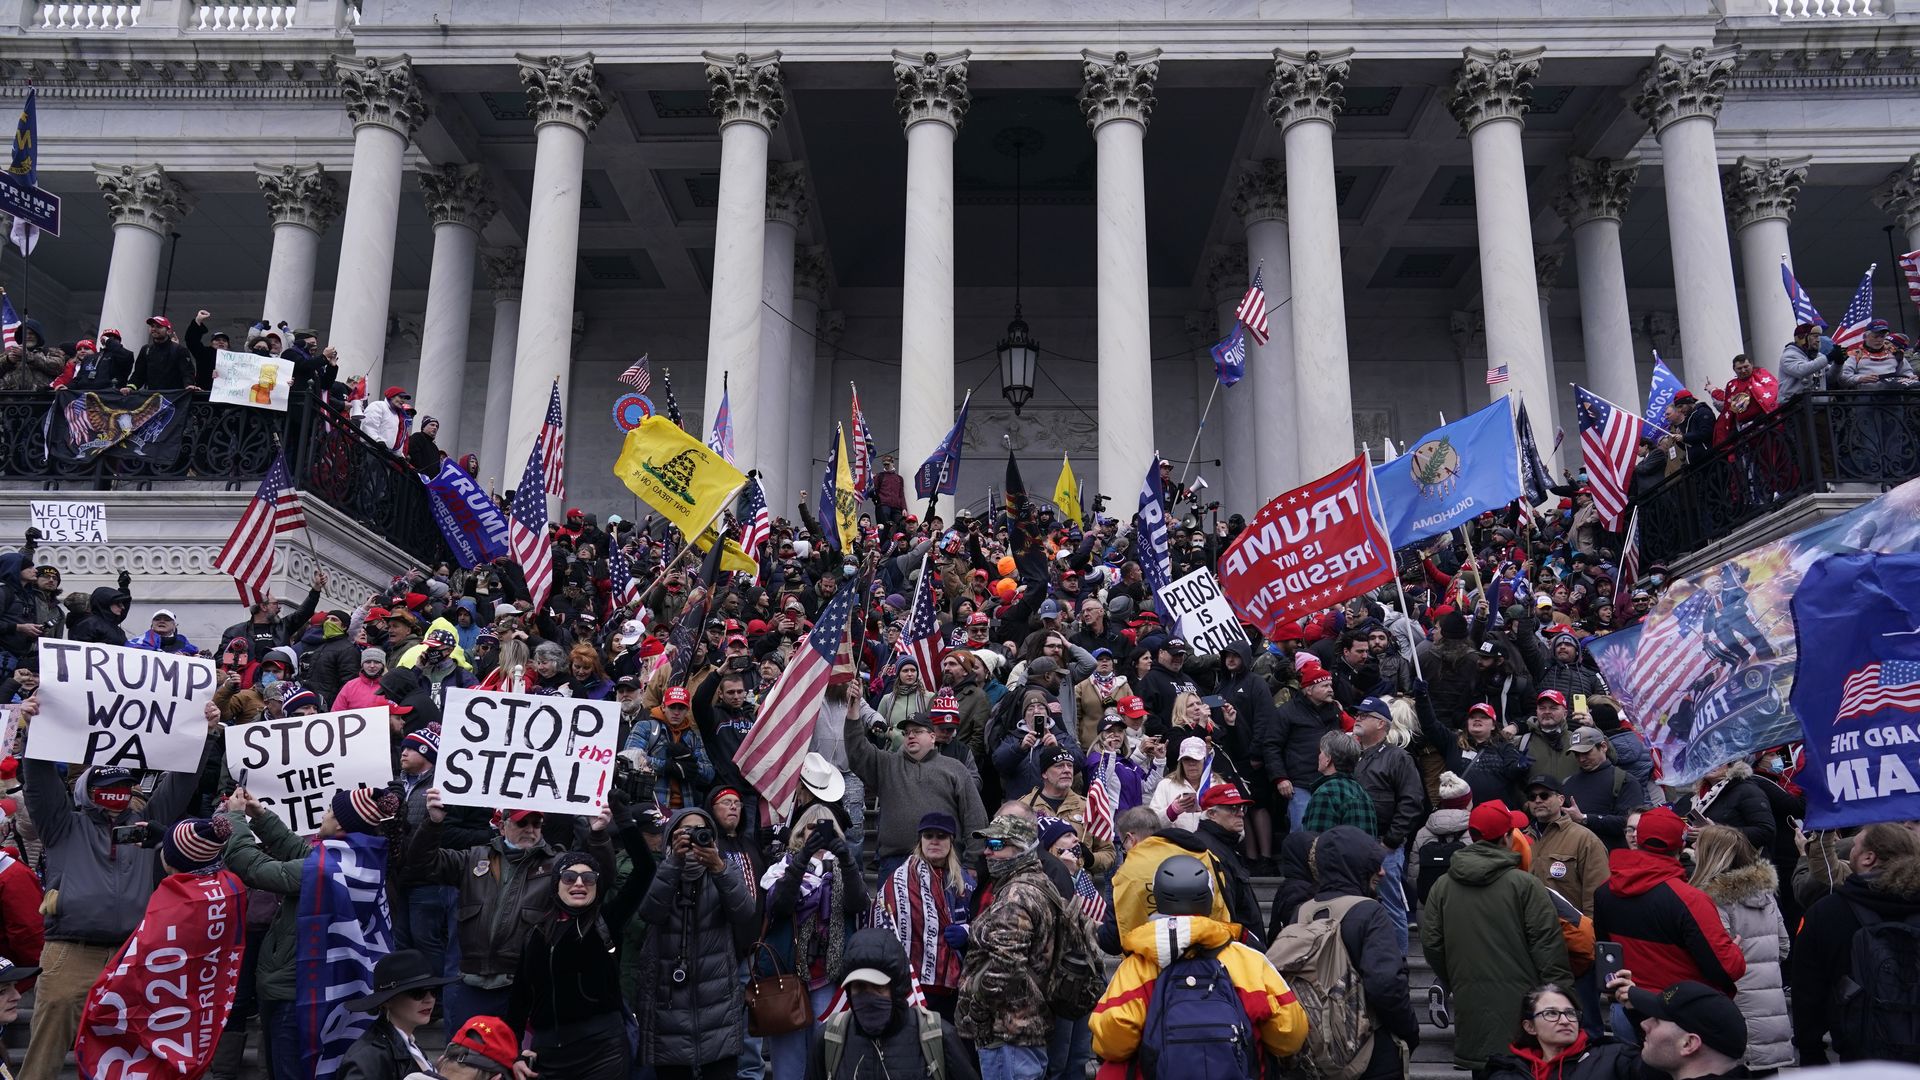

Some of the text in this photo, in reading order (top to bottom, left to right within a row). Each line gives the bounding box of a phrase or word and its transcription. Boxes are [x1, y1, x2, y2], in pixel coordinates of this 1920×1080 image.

[0, 181, 56, 212] TRUMP
[4, 193, 51, 218] PENCE
[31, 503, 105, 519] WELCOME
[37, 517, 99, 531] TO THE
[440, 463, 510, 547] TRUMP
[444, 514, 477, 564] BULLSHIT
[1163, 571, 1220, 617] PELOSI
[1192, 615, 1245, 656] SATAN
[1195, 608, 1213, 628] IS
[43, 642, 212, 701] TRUMP
[86, 691, 177, 735] WON
[460, 696, 604, 757] STOP
[83, 730, 148, 769] PA
[242, 713, 367, 770] STOP
[578, 745, 613, 765] the
[276, 762, 336, 793] THE
[442, 748, 606, 807] STEAL!
[925, 926, 938, 949] But
[921, 950, 936, 983] They
